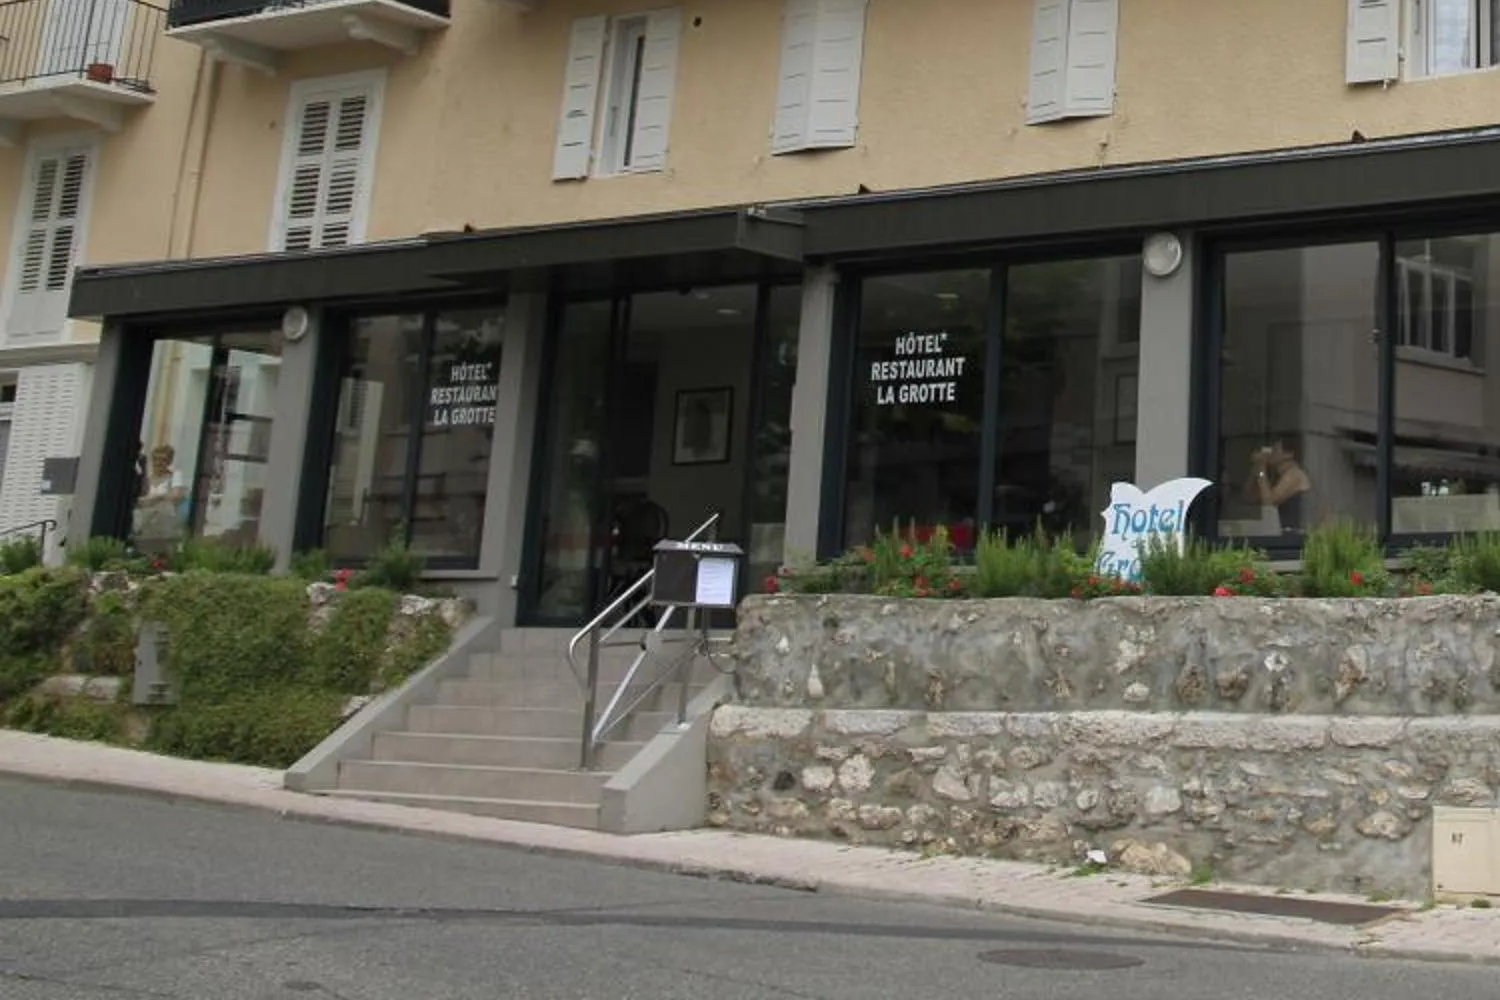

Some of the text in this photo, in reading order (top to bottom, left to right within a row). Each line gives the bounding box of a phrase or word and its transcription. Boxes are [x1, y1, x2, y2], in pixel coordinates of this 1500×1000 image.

[871, 357, 966, 381] RESTAURANT
[430, 385, 497, 405] RESTAURAN
[877, 382, 956, 405] LA GROTTE
[433, 406, 496, 426] LA GROTTE
[675, 542, 724, 552] MENU
